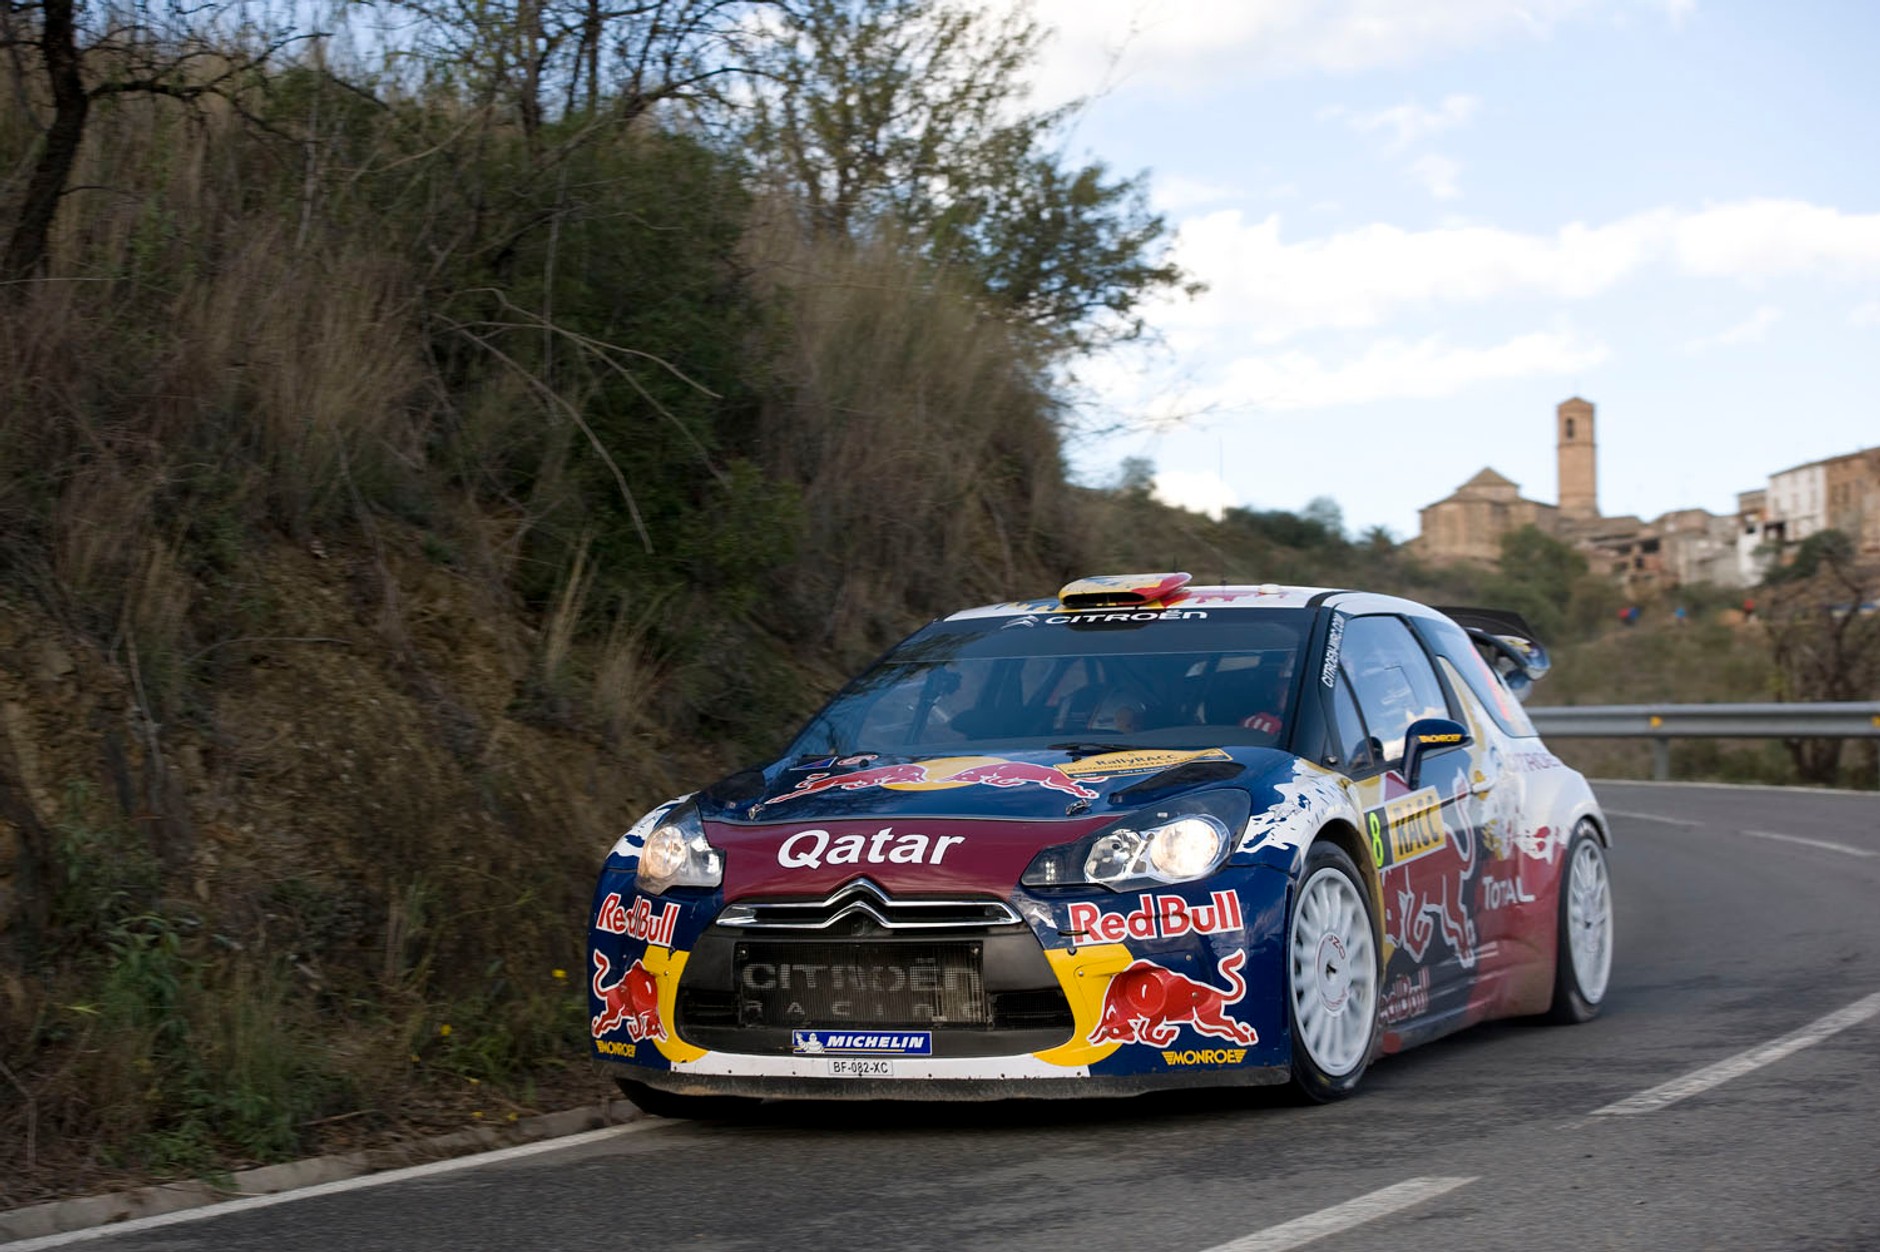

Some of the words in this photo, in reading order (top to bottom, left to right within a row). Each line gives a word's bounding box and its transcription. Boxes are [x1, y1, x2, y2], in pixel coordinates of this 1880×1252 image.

[1392, 796, 1440, 855] RACC
[1369, 812, 1384, 867] 8
[777, 827, 966, 869] Qatar
[600, 1041, 632, 1056] MONROE
[826, 1035, 924, 1048] MICHELIN
[1173, 1049, 1236, 1065] MONROE
[833, 1061, 888, 1073] BF-082-XC
